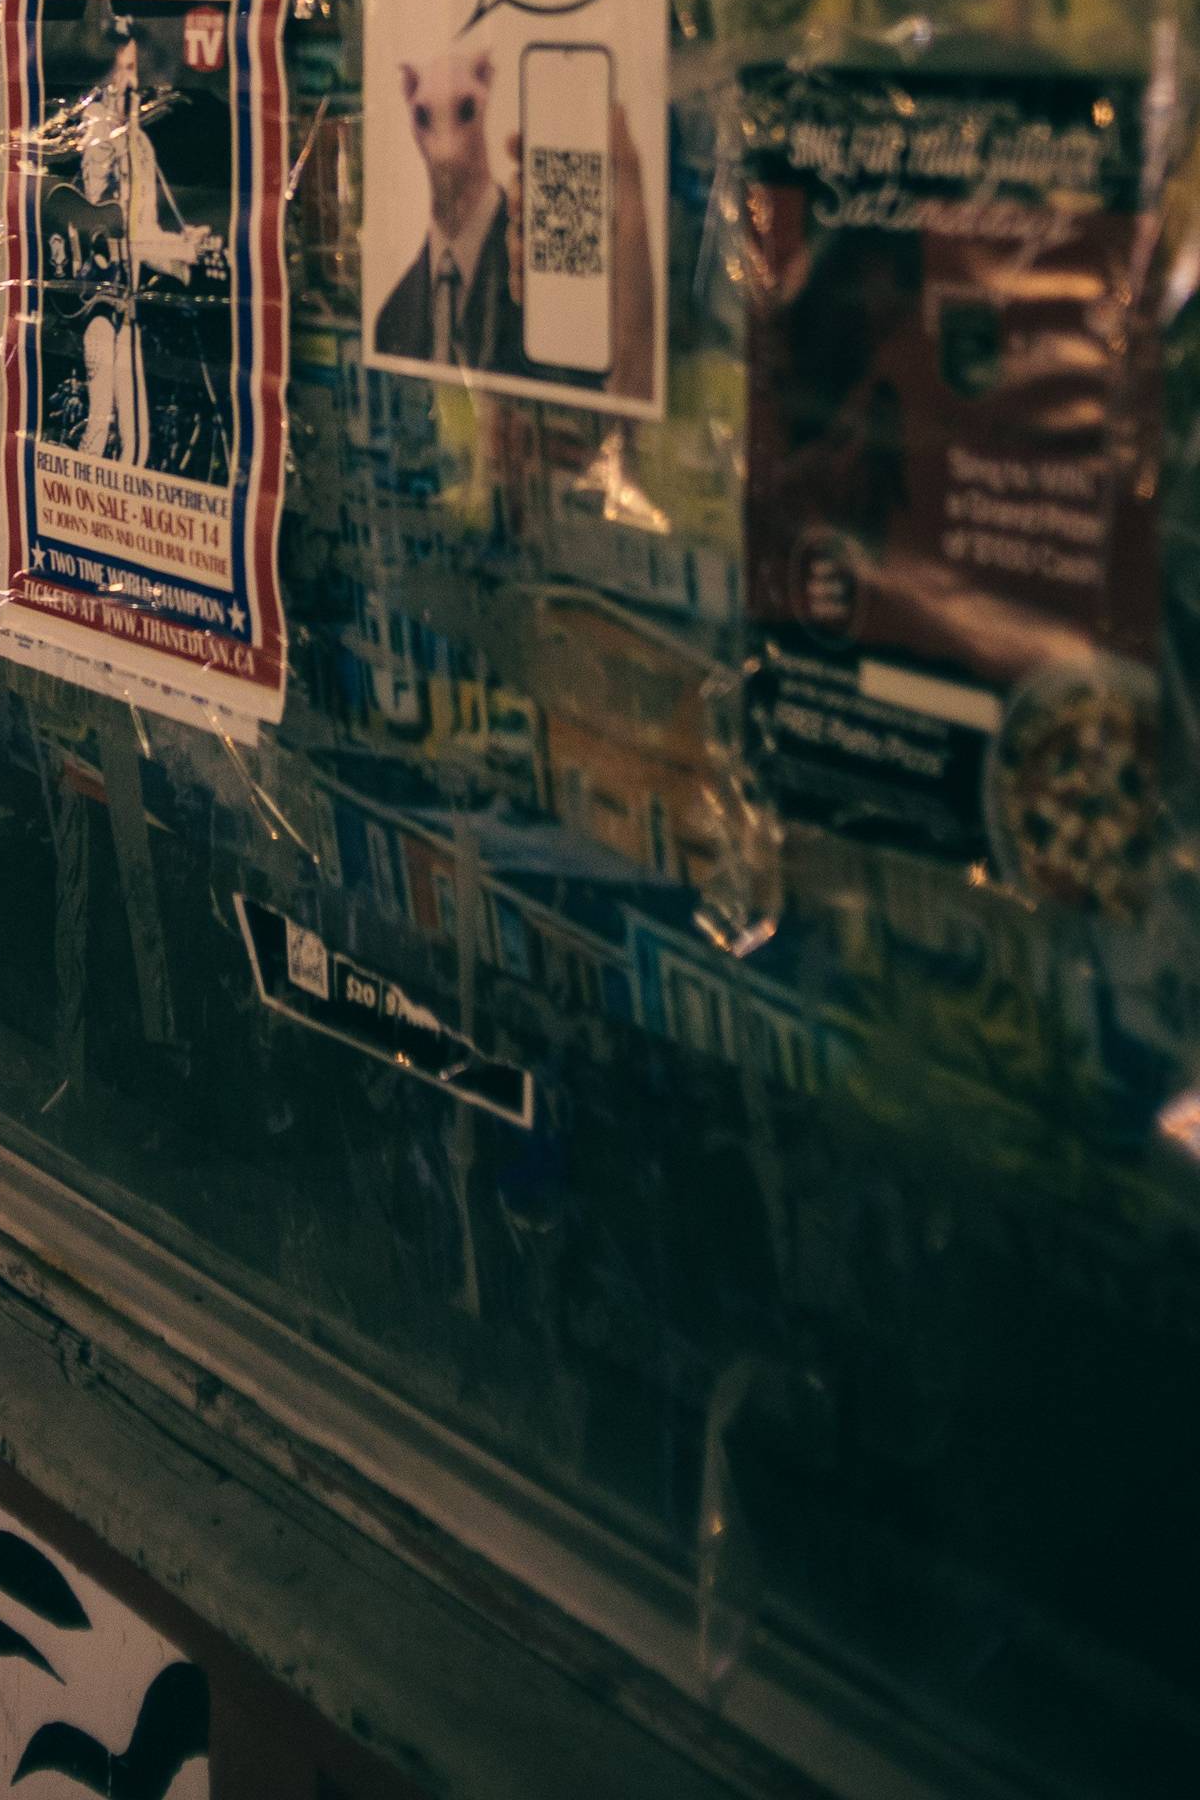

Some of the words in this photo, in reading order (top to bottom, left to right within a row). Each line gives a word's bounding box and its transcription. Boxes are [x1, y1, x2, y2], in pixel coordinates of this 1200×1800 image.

[184, 28, 225, 68] TV
[36, 450, 71, 479] RELIVE
[72, 460, 92, 483] THE
[94, 465, 121, 492] FULL
[122, 473, 154, 499] ELVIS
[155, 481, 228, 519] EXPERIENCE
[42, 477, 72, 507] NOW
[75, 485, 95, 513] ON
[97, 493, 131, 525] SALE
[140, 504, 196, 542] AUGUST
[201, 521, 220, 549] 14
[56, 510, 89, 536] JOHN'S
[90, 519, 115, 542] ARTS
[115, 526, 135, 549] AND
[135, 532, 186, 565] CULTURAL
[189, 547, 228, 575] CENTRE
[22, 578, 77, 616] TICKETS
[79, 600, 98, 623] AT
[47, 548, 78, 578] TWO
[75, 556, 104, 585] TIME
[153, 577, 226, 625] CHAMPION
[346, 974, 376, 1009] $20
